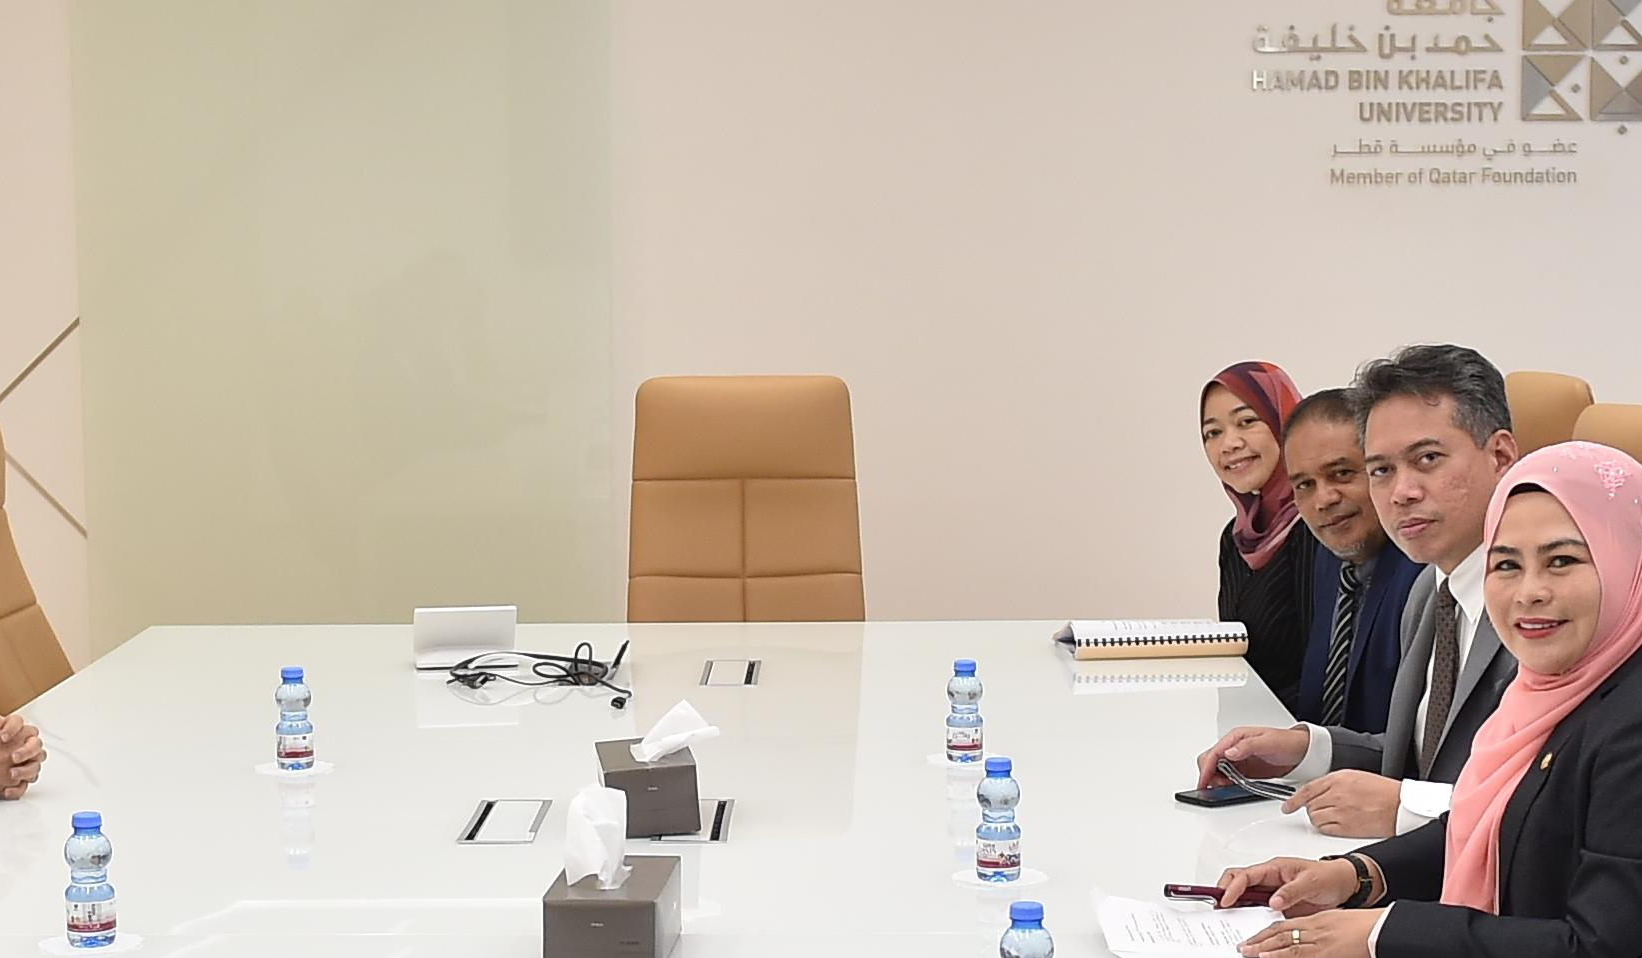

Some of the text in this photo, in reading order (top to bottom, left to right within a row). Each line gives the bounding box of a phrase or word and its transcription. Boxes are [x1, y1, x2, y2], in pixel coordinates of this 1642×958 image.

[1252, 22, 1504, 62] حمد بن خليفة
[1251, 69, 1504, 91] HAMAD BIN KHALIFA
[1359, 101, 1504, 123] UNIVERSITY
[1331, 138, 1578, 161] عضو في مؤسسة قطر
[1329, 167, 1578, 186] Member of Qatar Foundation
